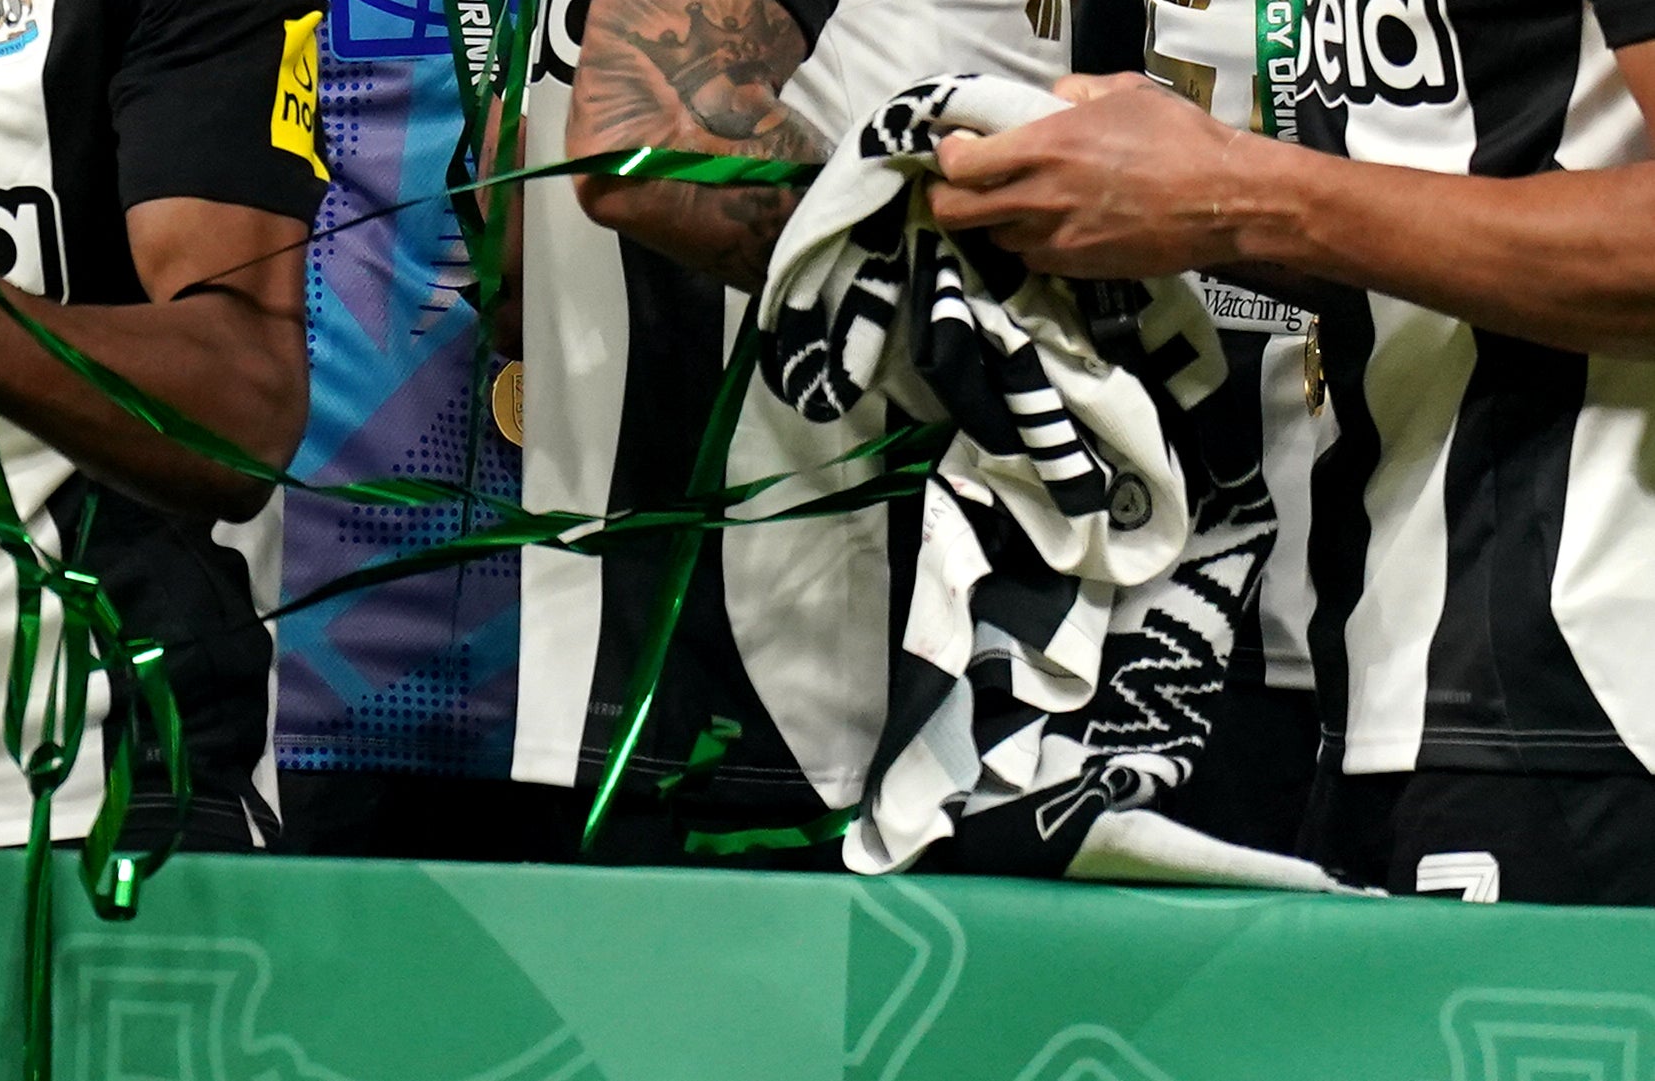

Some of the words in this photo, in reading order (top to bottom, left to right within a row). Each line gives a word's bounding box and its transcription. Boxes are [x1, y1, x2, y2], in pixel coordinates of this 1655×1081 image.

[282, 90, 313, 133] no
[1267, 57, 1300, 144] DRIN
[1202, 286, 1303, 332] Watching
